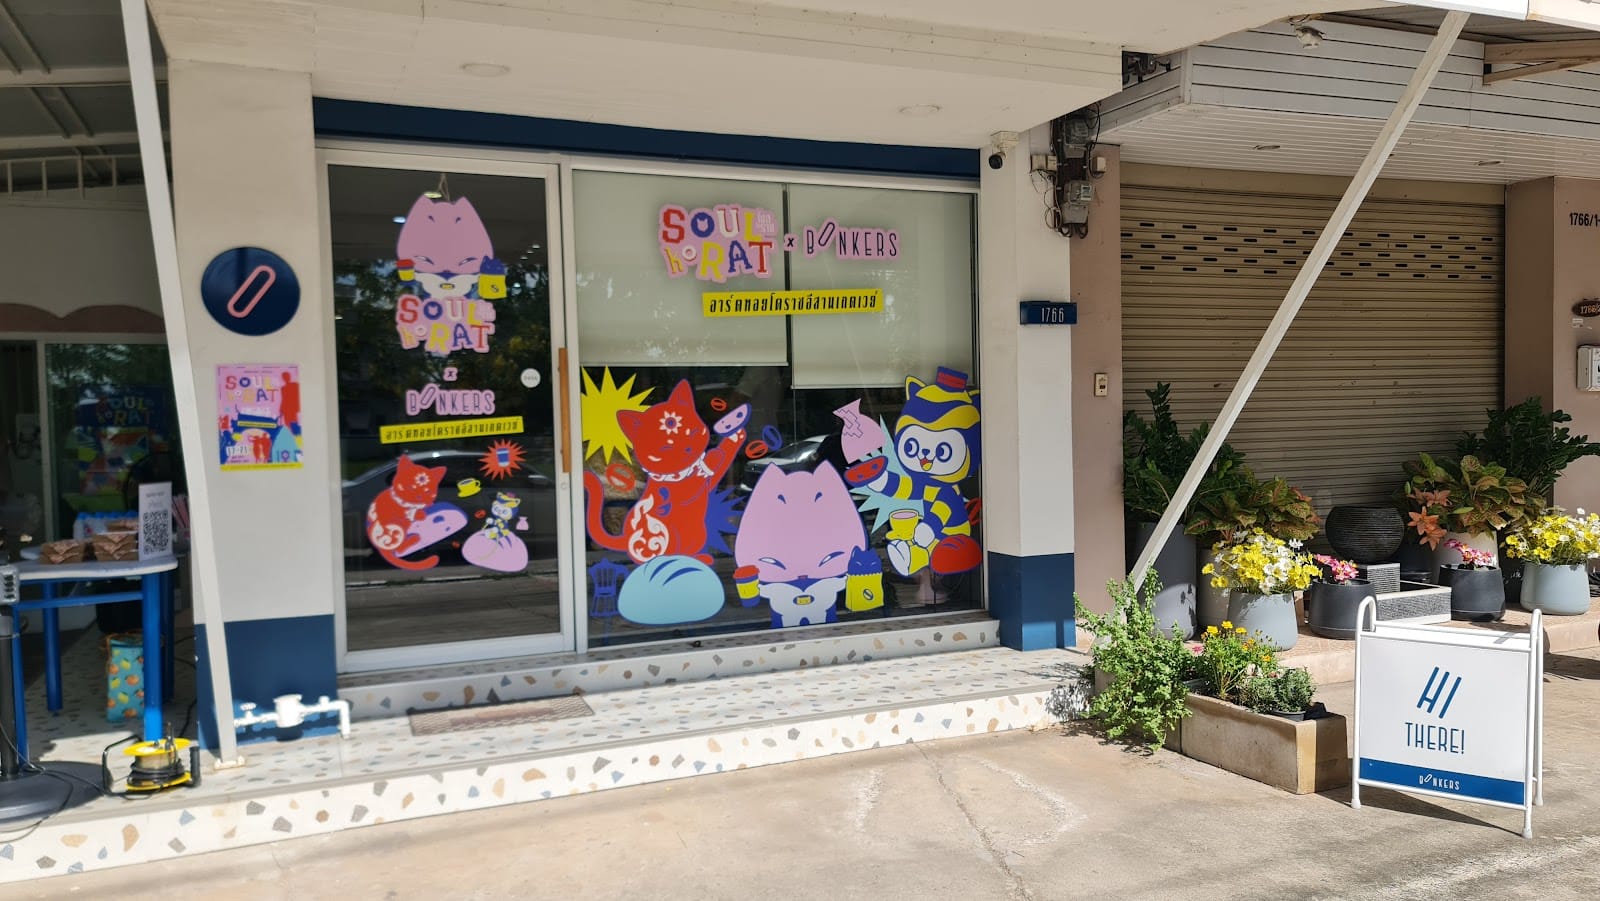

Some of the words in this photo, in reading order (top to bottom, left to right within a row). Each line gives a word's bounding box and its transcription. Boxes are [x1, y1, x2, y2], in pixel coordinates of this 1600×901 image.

[662, 208, 762, 243] SOUL
[806, 221, 897, 257] BONKERS
[399, 297, 482, 326] SOUL
[1041, 307, 1065, 323] 1766
[409, 386, 493, 412] BONKERS
[1416, 666, 1462, 719] HI
[1404, 721, 1465, 755] THERE!
